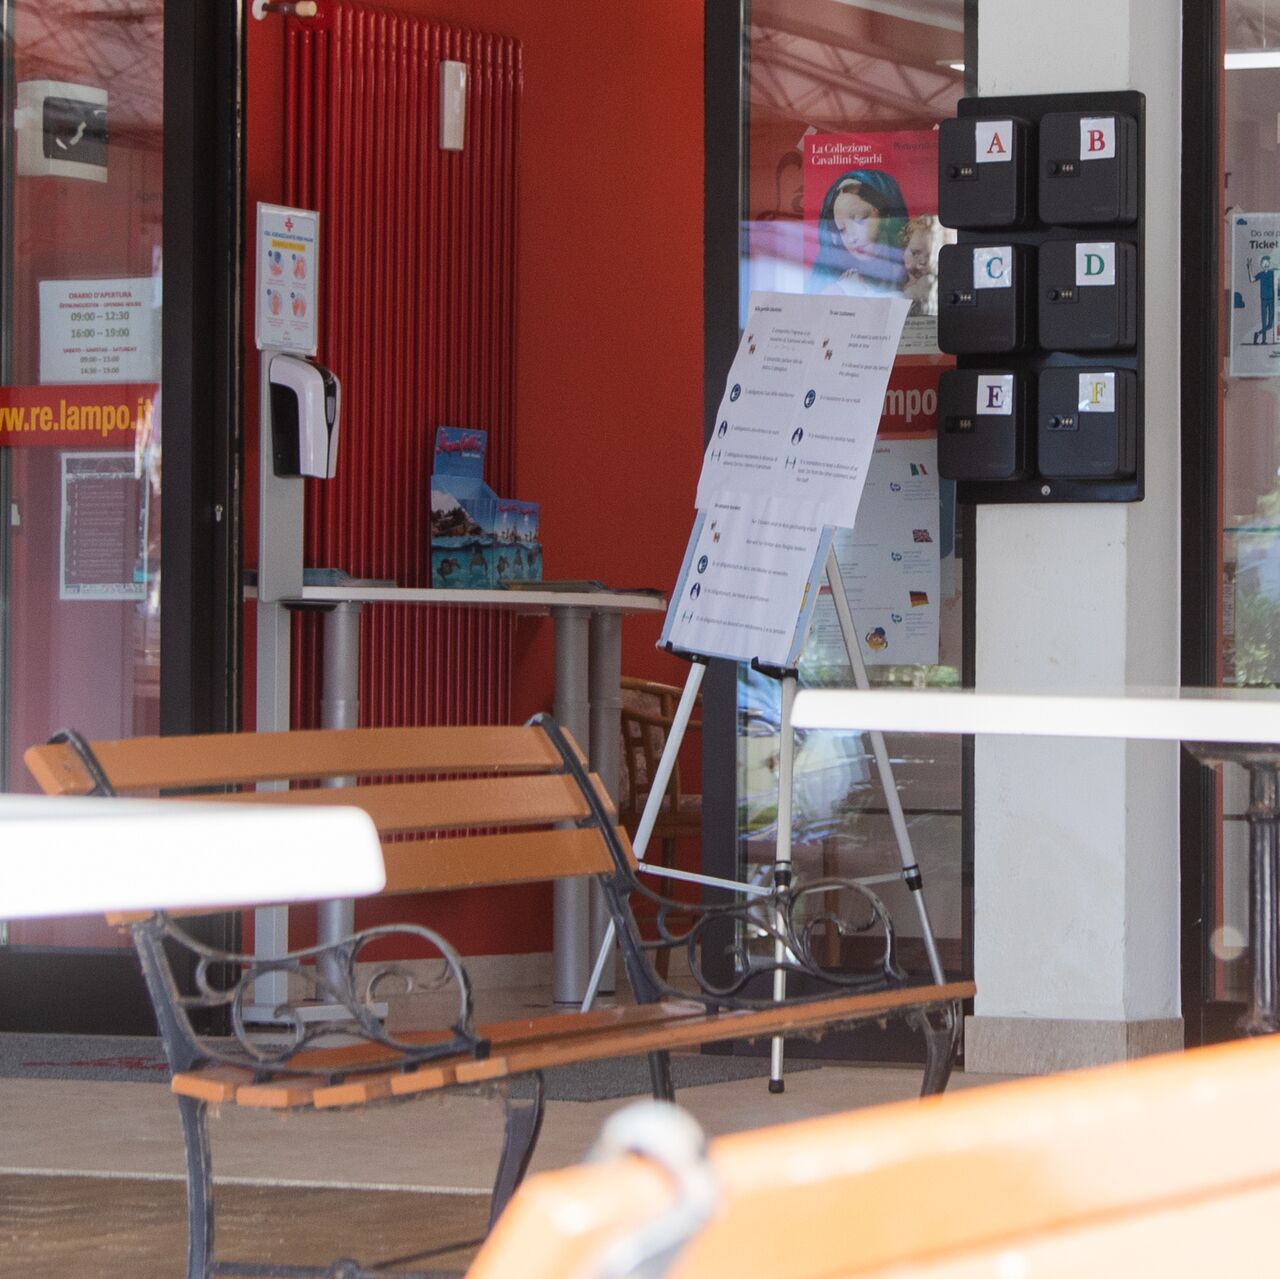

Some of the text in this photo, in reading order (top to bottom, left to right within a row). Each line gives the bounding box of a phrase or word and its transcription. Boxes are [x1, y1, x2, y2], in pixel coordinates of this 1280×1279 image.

[811, 142, 872, 154] La Collezione
[986, 132, 1007, 154] A
[1087, 129, 1106, 152] B
[811, 154, 883, 167] Cavallini Sgarbi
[1249, 239, 1279, 250] Ticket
[985, 257, 1004, 279] C
[1084, 254, 1105, 276] D
[70, 311, 130, 321] 09:00 12:30
[985, 385, 1004, 409] E
[1089, 381, 1107, 404] F
